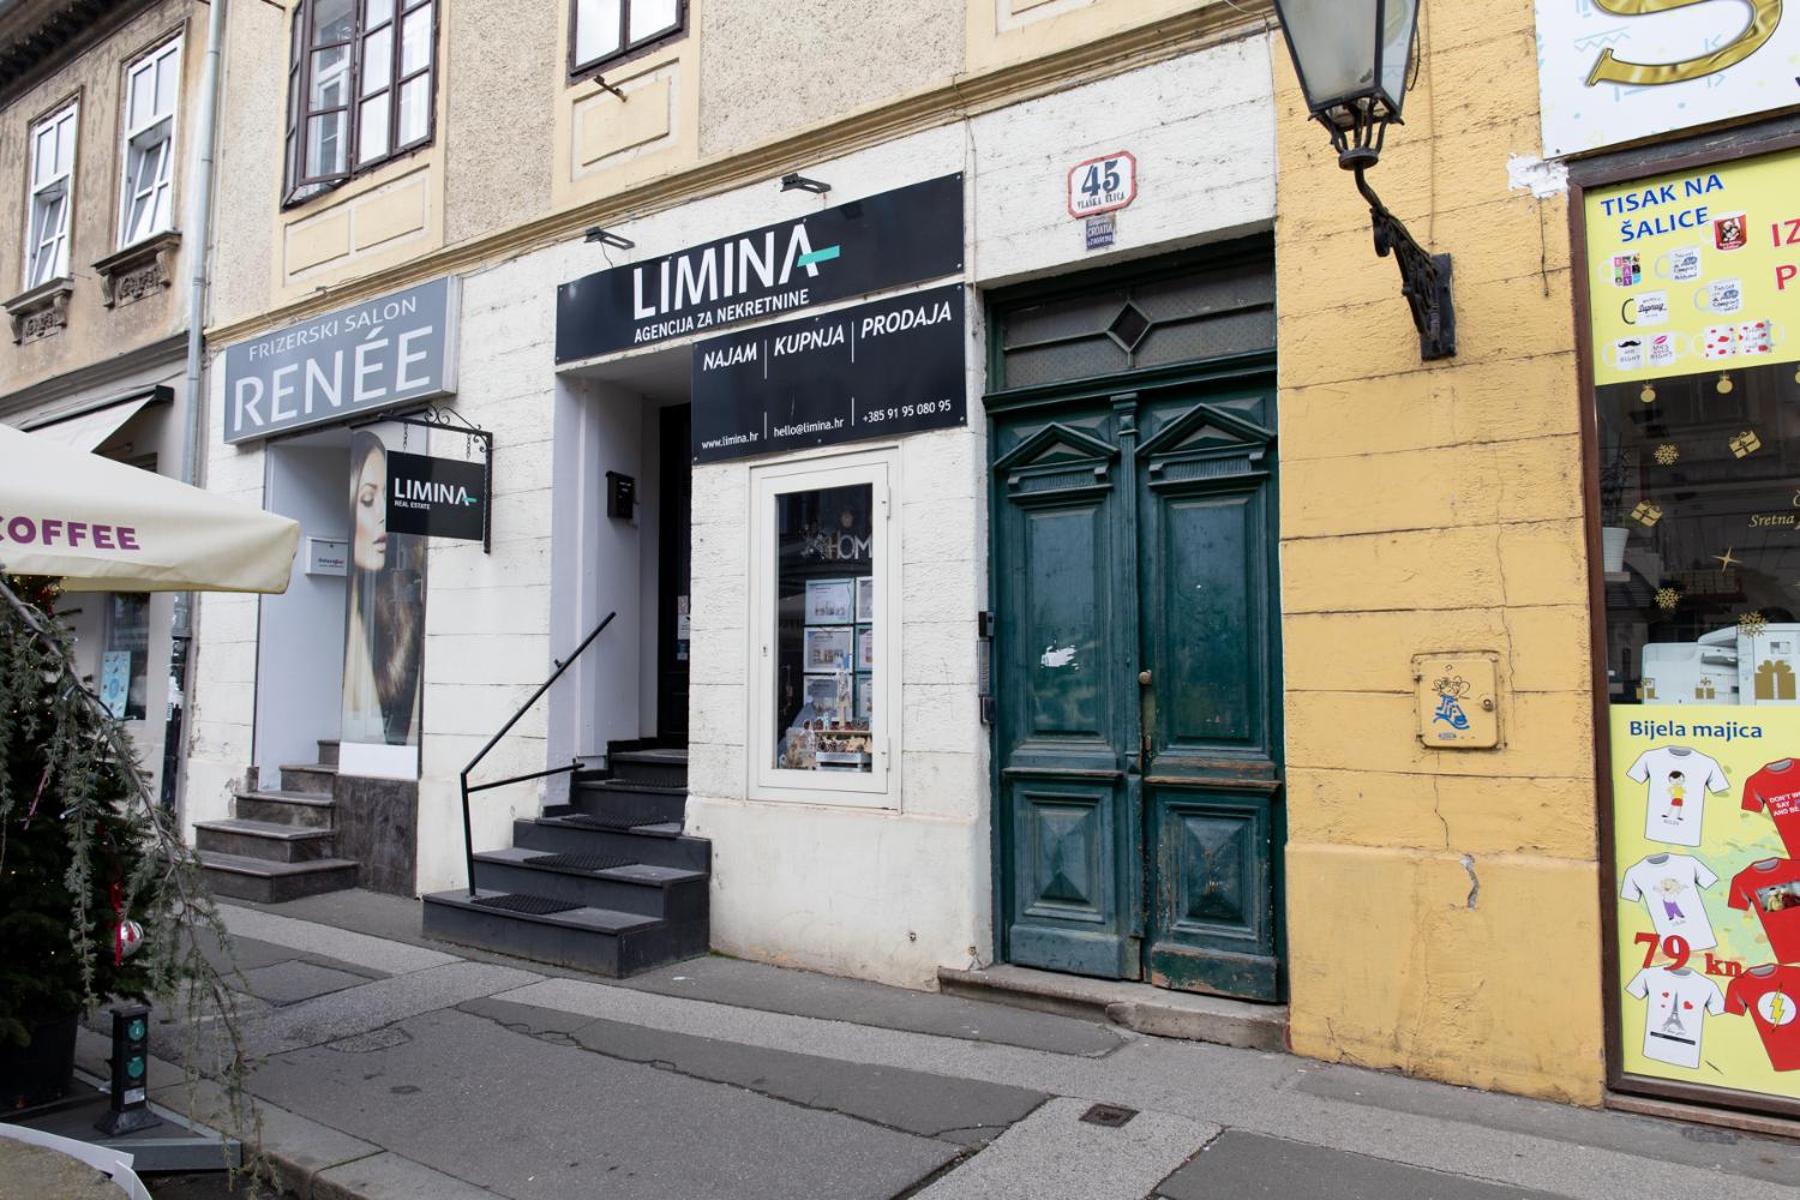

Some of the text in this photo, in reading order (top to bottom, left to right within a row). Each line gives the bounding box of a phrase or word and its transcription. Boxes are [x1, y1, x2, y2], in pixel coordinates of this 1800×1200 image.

[1081, 160, 1120, 196] 45
[1601, 173, 1725, 217] TISAK NA
[1620, 206, 1709, 242] ŠALICE
[634, 223, 840, 320] LIMINA
[248, 295, 416, 362] FRIZERSKI SALON
[634, 288, 810, 343] AGENCIJA ZA NEKRETNINE
[703, 300, 952, 371] NAJAM KUPNJA PRODAJA
[234, 325, 433, 432] RENÉE
[701, 399, 952, 449] www.limina.hr hello@limina.hr +385 91 95 080 95
[394, 477, 477, 506] LIMINA
[394, 500, 431, 510] REAL ESTATE
[1748, 514, 1795, 528] Sretna
[1629, 720, 1763, 744] Bijela majica
[1634, 932, 1743, 978] 79 kn
